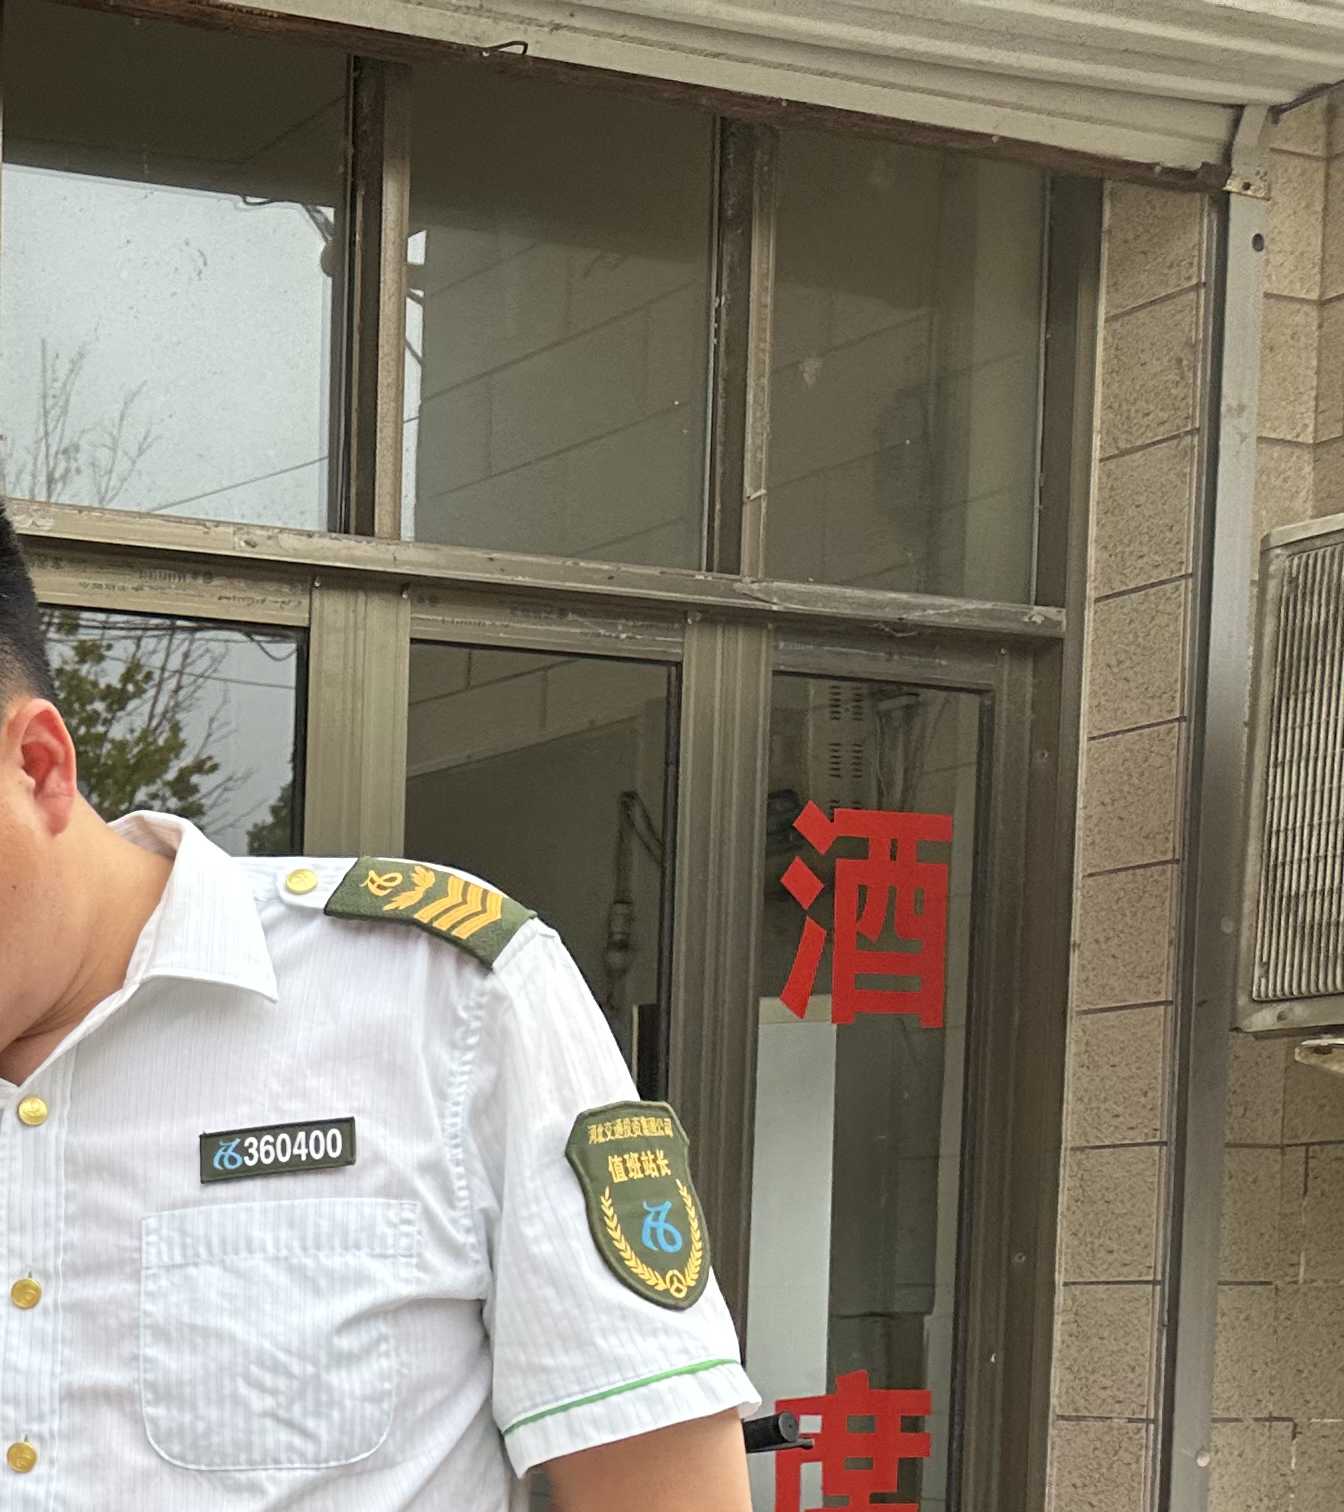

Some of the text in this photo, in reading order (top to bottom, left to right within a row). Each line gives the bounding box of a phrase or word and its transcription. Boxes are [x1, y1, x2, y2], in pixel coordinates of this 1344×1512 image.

[243, 1128, 343, 1166] 360400
[608, 1149, 671, 1183] 值班站长
